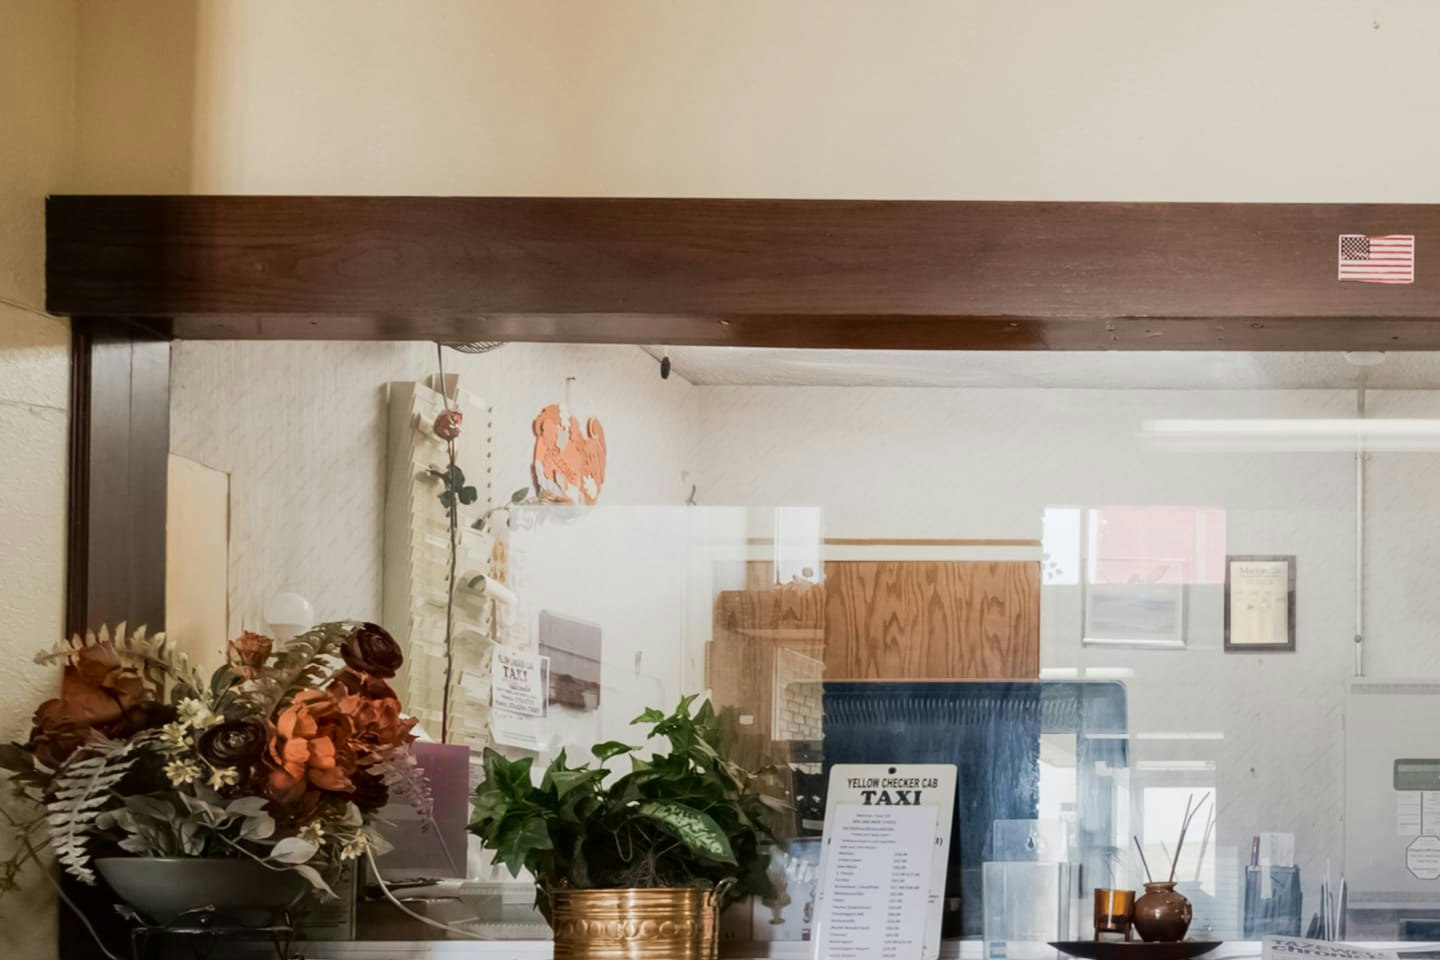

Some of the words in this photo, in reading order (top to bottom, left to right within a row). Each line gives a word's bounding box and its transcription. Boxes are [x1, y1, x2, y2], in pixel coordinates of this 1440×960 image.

[847, 778, 880, 788] YELLOW
[881, 778, 920, 788] CHECKER
[921, 778, 938, 788] CAB
[860, 790, 922, 806] TAXI
